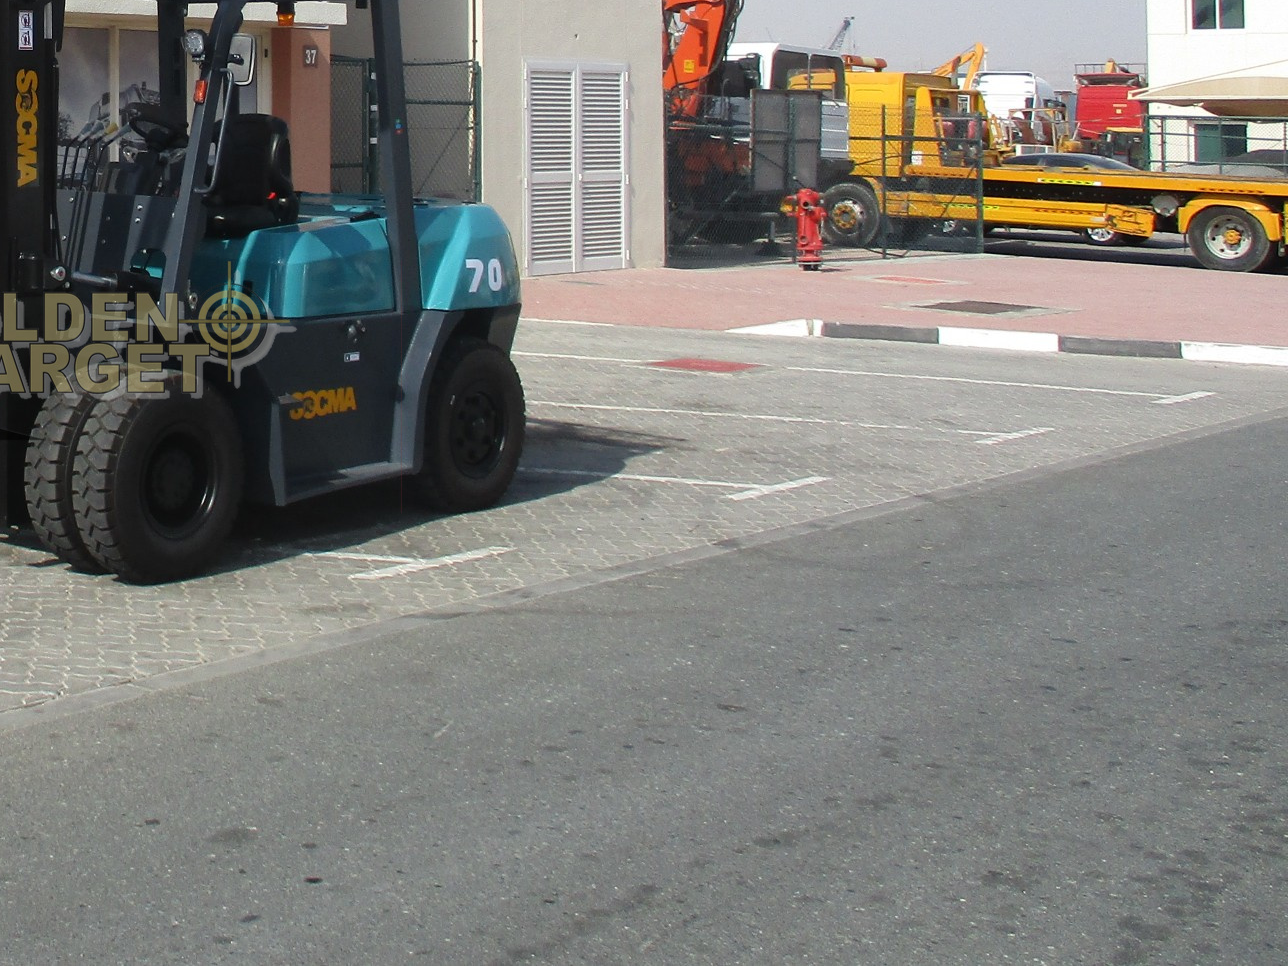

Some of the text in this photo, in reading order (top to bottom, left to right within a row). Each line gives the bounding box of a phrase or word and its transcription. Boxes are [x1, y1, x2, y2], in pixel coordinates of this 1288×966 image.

[305, 49, 317, 64] 37
[15, 68, 39, 187] SOCMA
[465, 258, 502, 293] 70
